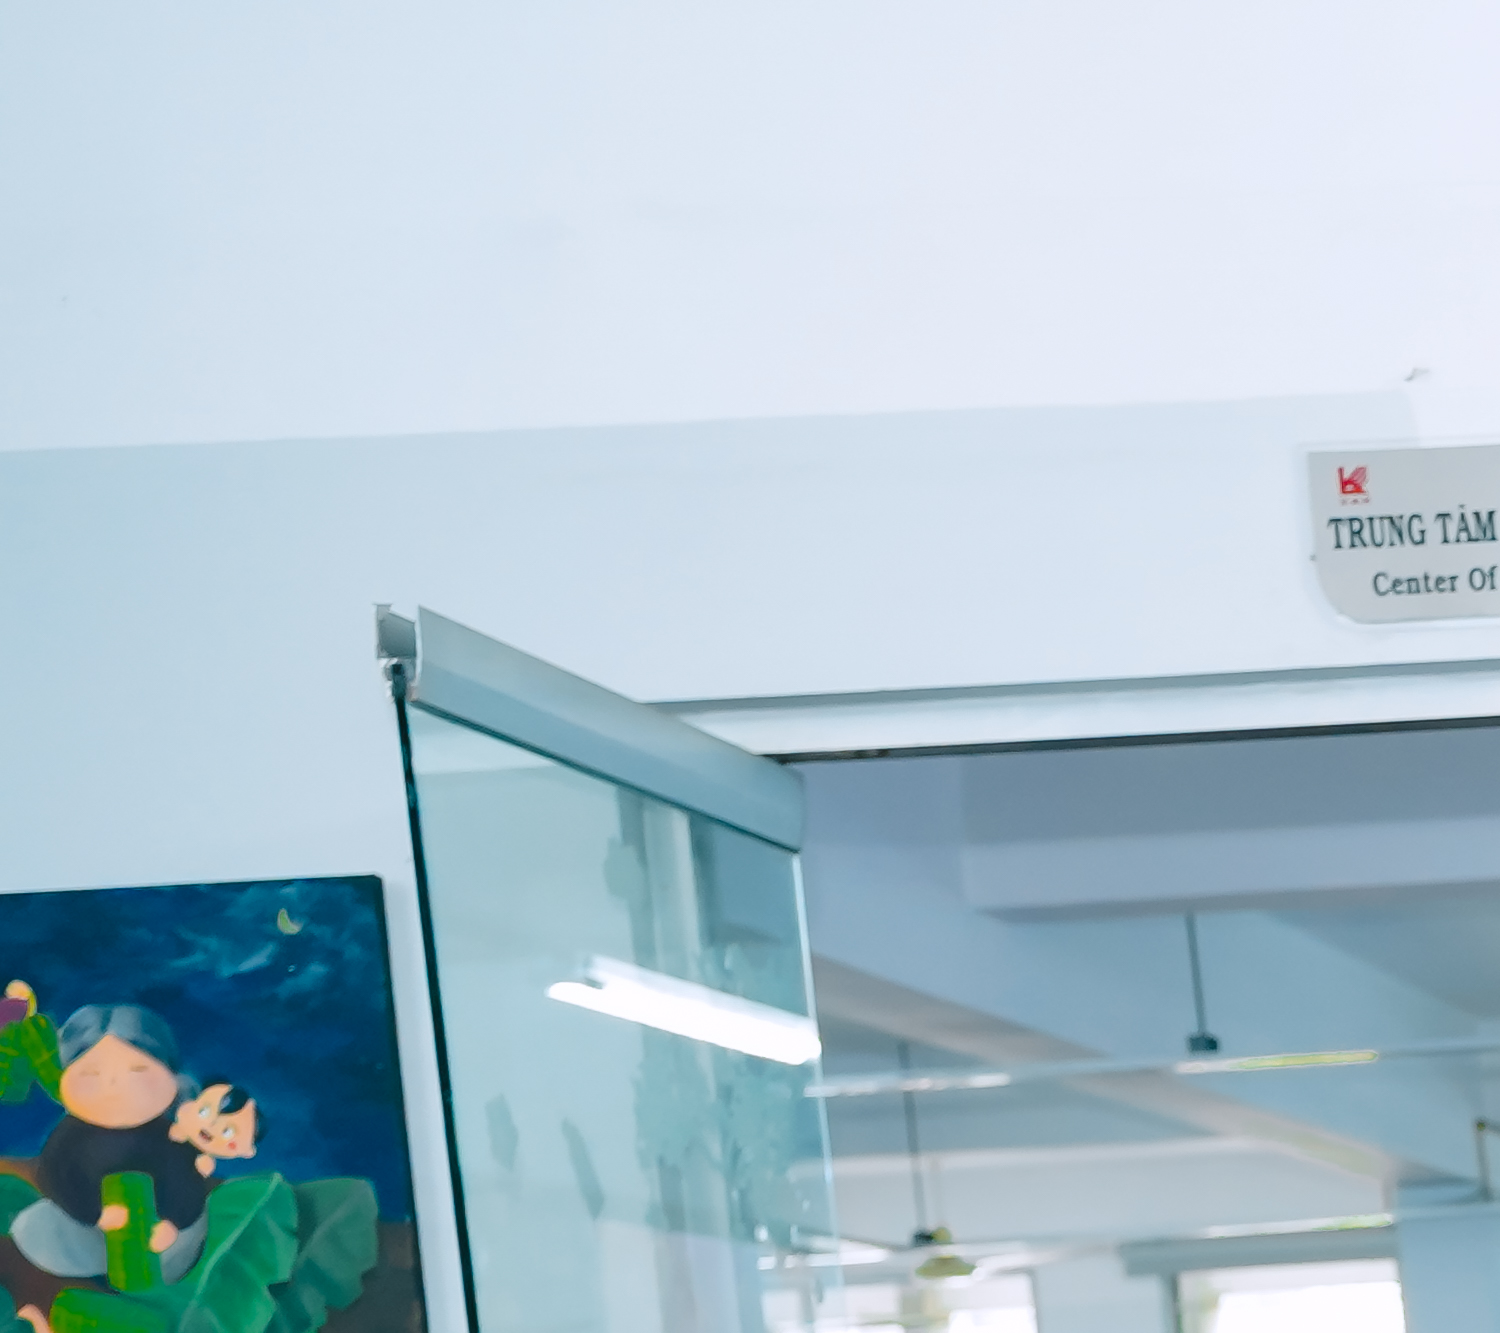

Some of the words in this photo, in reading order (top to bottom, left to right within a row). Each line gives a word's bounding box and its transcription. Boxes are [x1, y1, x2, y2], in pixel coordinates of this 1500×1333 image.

[1328, 514, 1427, 551] TRUNG
[1435, 501, 1499, 545] TÂM
[1373, 566, 1458, 597] Center
[1470, 566, 1498, 590] Of
